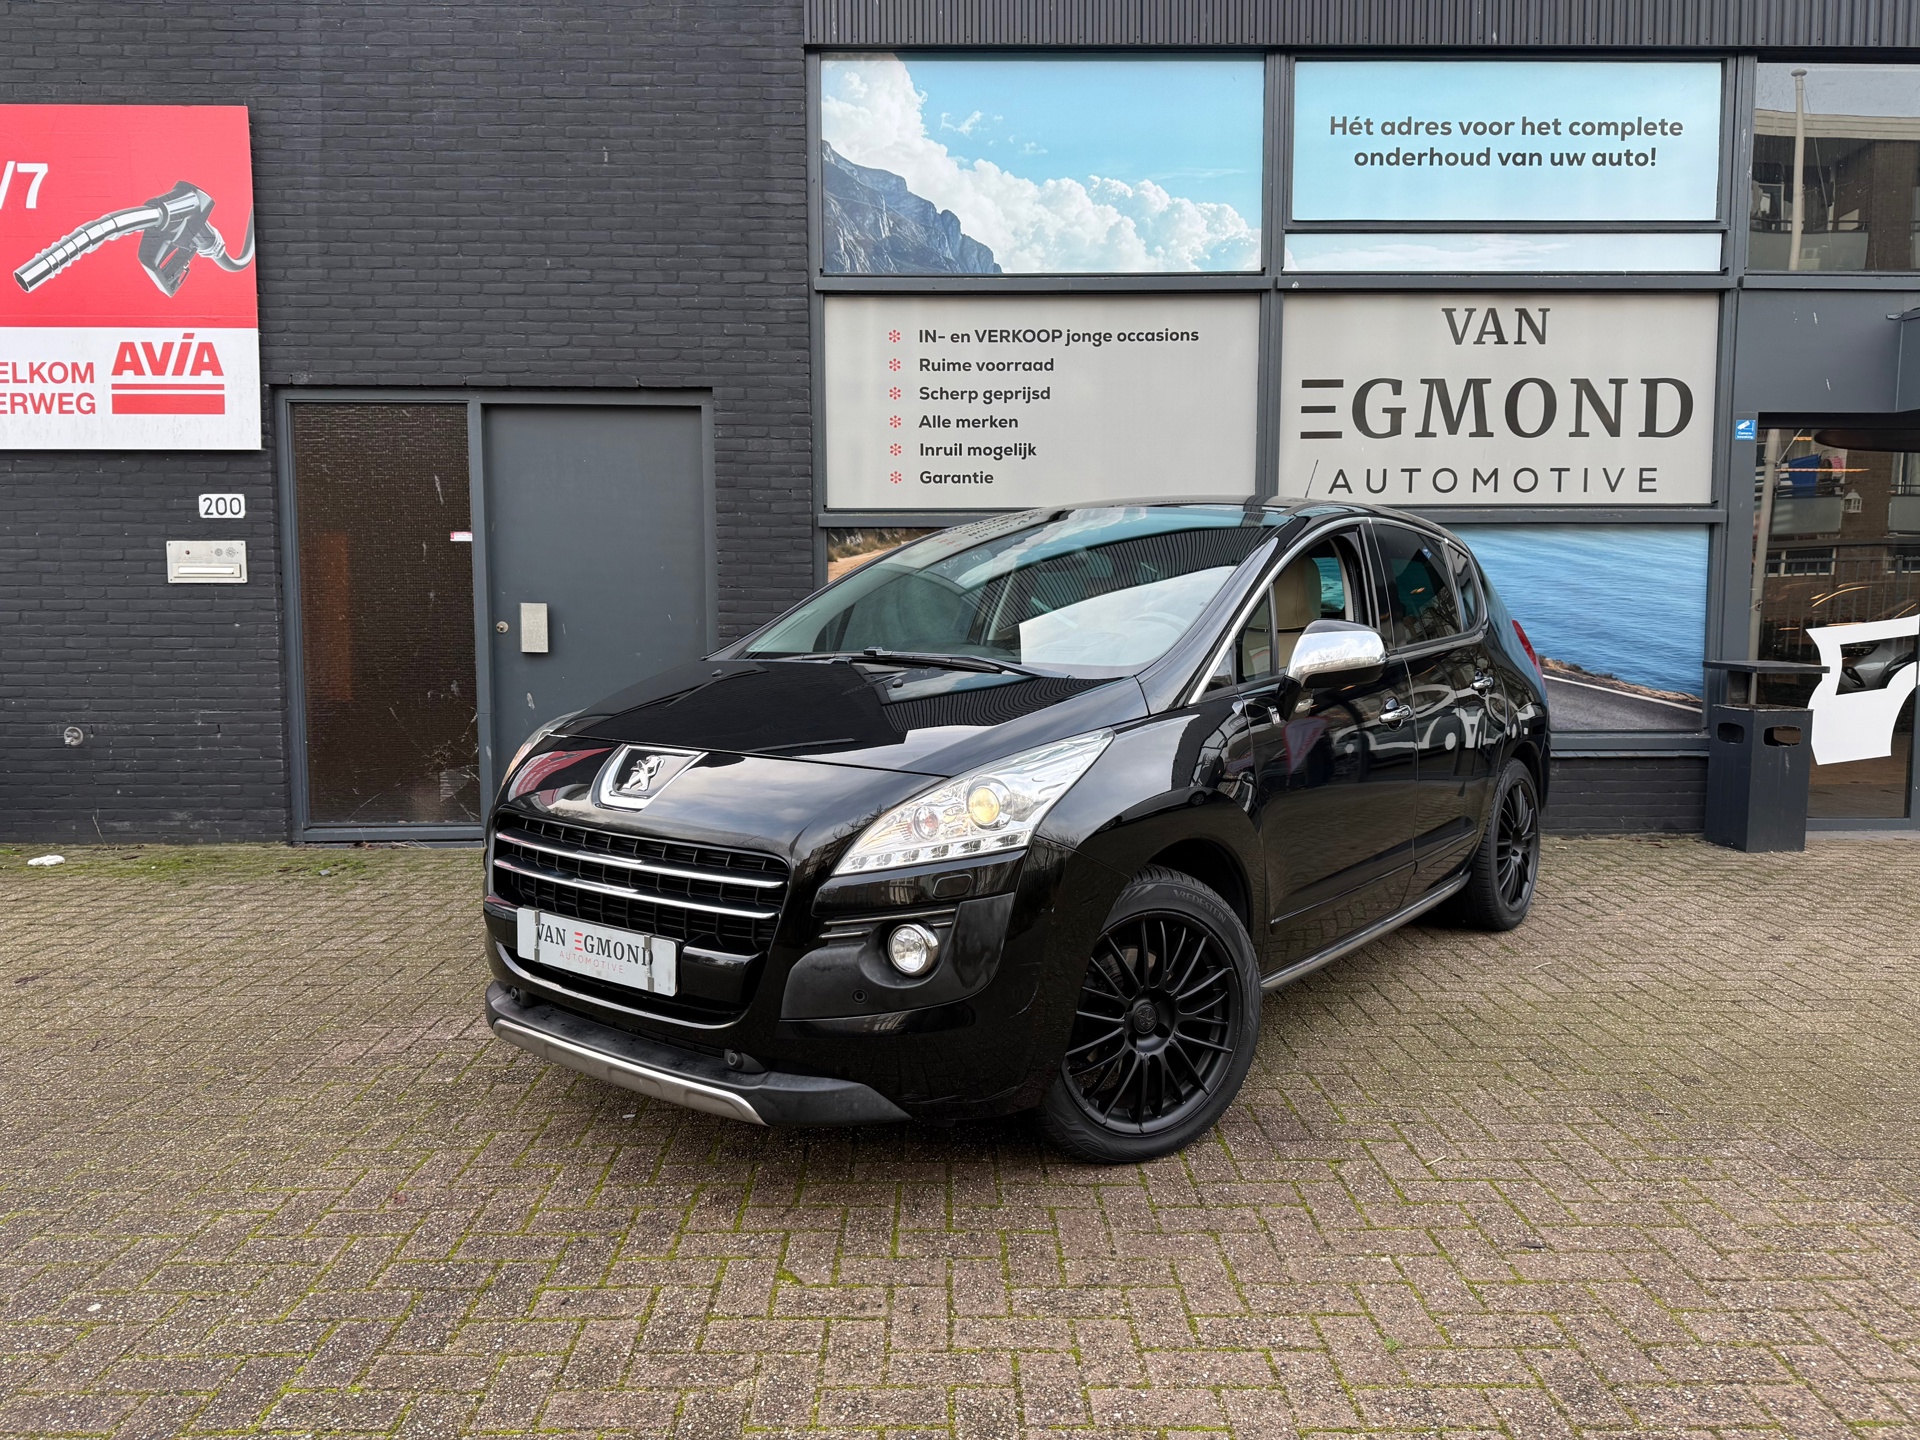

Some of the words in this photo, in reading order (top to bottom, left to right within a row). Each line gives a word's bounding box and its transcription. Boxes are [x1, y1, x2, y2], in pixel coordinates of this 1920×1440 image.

[1330, 115, 1374, 136] Hét
[1380, 116, 1453, 136] adres
[1458, 121, 1516, 136] voor
[1521, 116, 1562, 136] het
[1568, 116, 1684, 142] complete
[1354, 147, 1491, 167] onderhoud
[1497, 152, 1543, 167] van
[1550, 152, 1587, 167] uw
[1592, 147, 1657, 167] auto!
[1441, 307, 1551, 346] VAN
[918, 329, 946, 343] IN-
[950, 332, 971, 343] en
[974, 329, 1063, 343] VERKOOP
[1065, 328, 1113, 347] jonge
[1117, 328, 1200, 343] occasions
[918, 358, 972, 372] Ruime
[976, 357, 1054, 372] voorraad
[918, 386, 979, 404] Scherp
[982, 386, 1051, 404] geprijsd
[1300, 377, 1694, 440] EGMOND
[918, 415, 952, 429] Alle
[955, 415, 1019, 429] merken
[919, 442, 963, 457] Inruil
[967, 442, 1037, 461] mogelijk
[919, 470, 994, 485] Garantie
[1327, 467, 1658, 494] AUTOMOTIVE
[203, 497, 242, 517] 200
[1173, 889, 1227, 923] VREDESTEIN
[537, 923, 566, 946] VAN
[574, 931, 654, 966] EGMOND
[559, 950, 624, 974] AUTOMOTIVE
